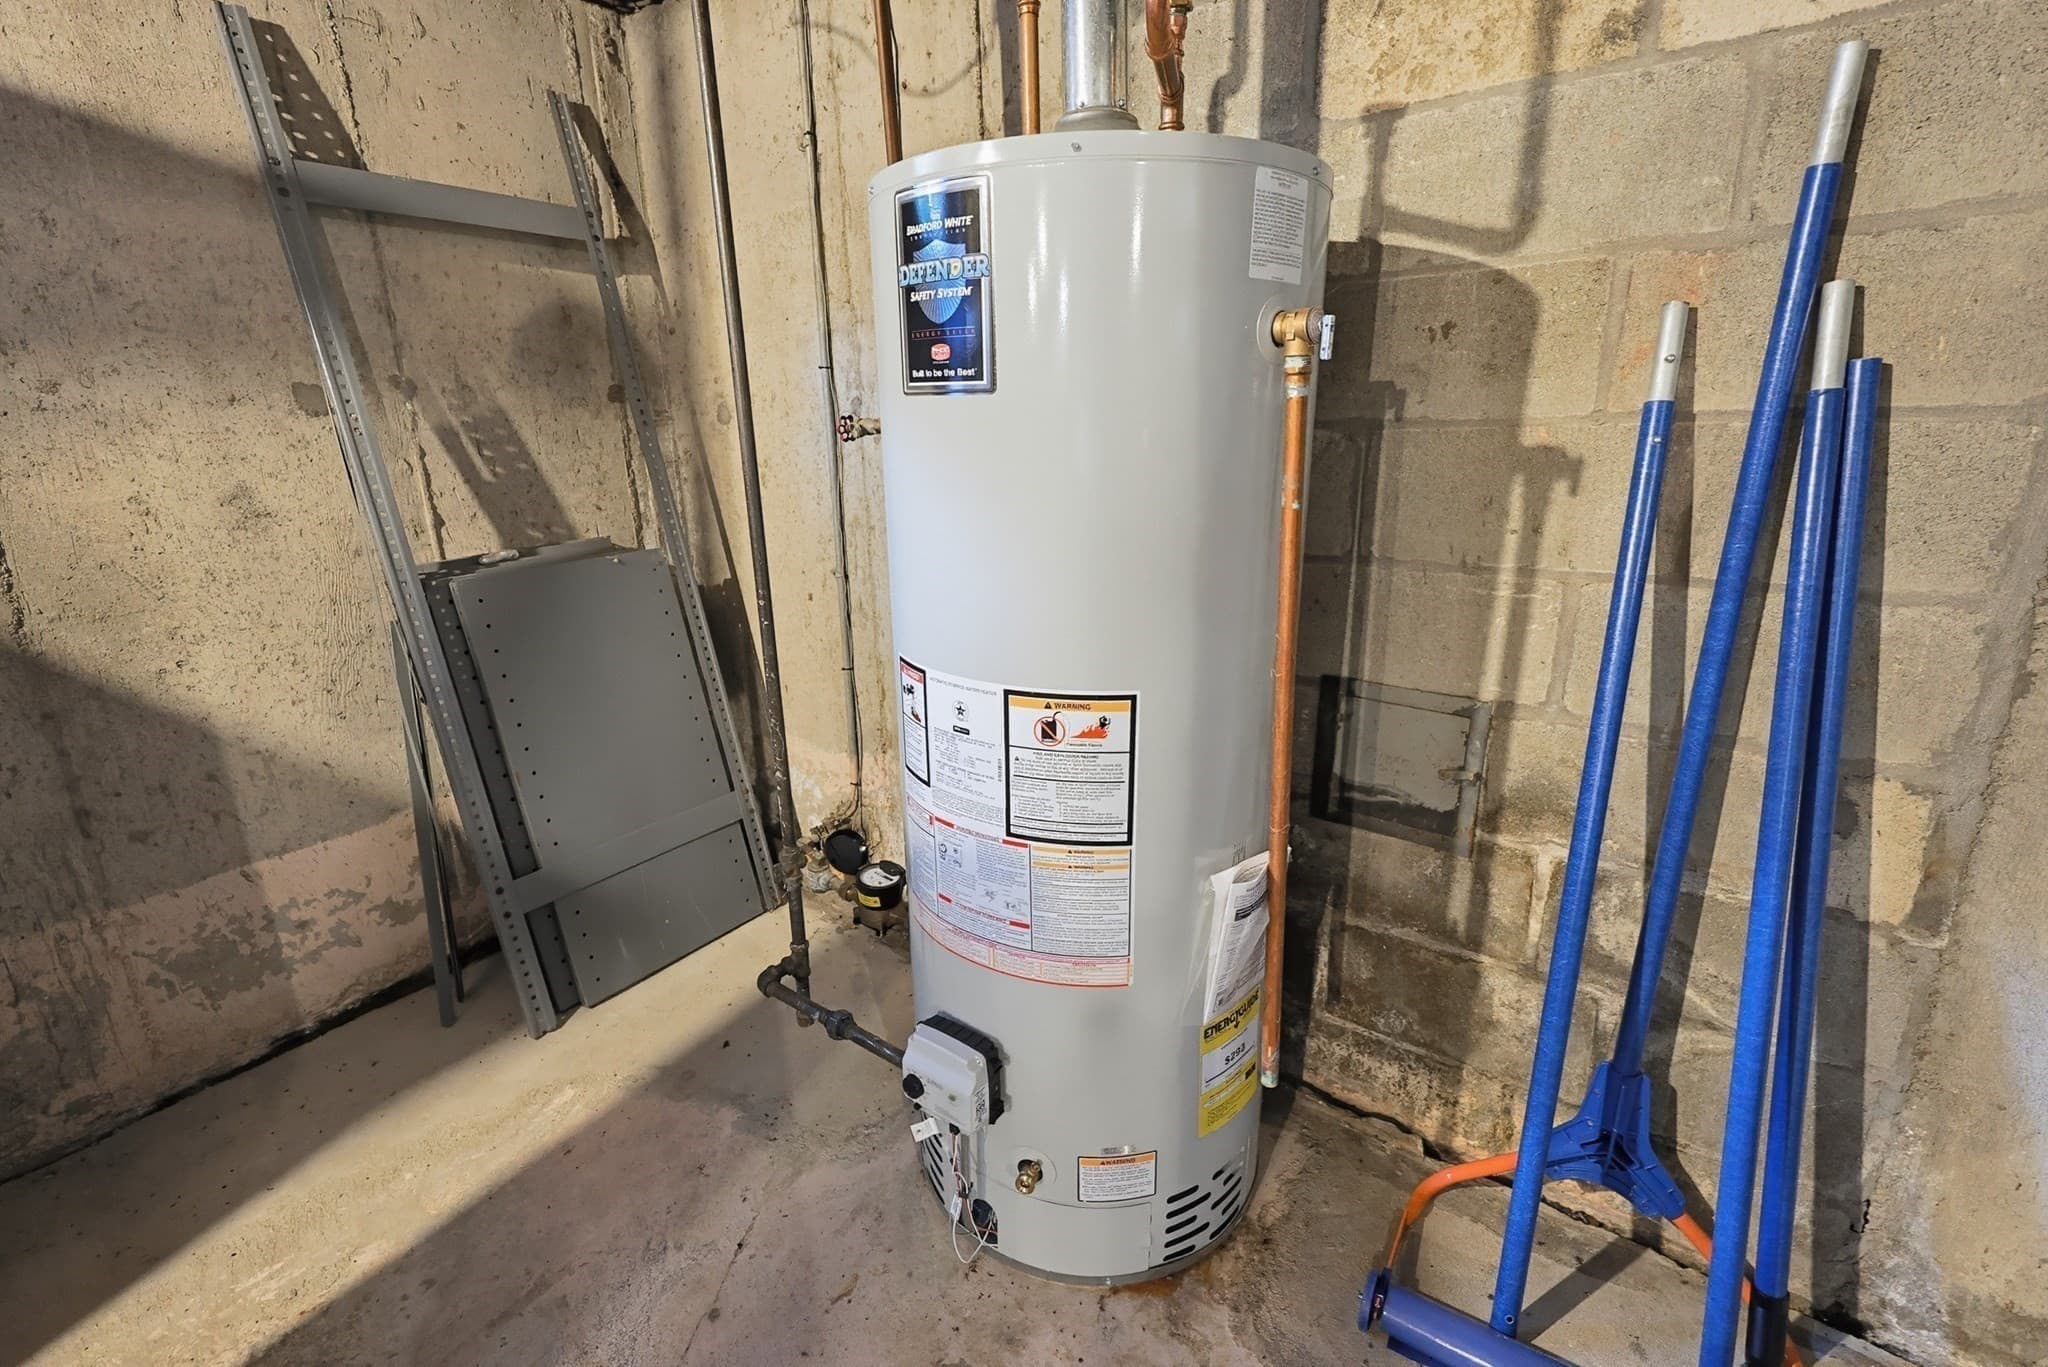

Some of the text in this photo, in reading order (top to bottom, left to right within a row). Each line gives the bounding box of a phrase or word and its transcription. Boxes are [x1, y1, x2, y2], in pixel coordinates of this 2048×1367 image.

[906, 221, 943, 236] BRADFORD
[944, 215, 974, 229] WHITE
[899, 253, 990, 287] DEFENDER
[910, 286, 973, 302] SAFETY SYSTEM
[925, 369, 933, 377] to
[933, 368, 943, 377] be
[943, 368, 955, 377] the
[1054, 702, 1092, 712] WARNING
